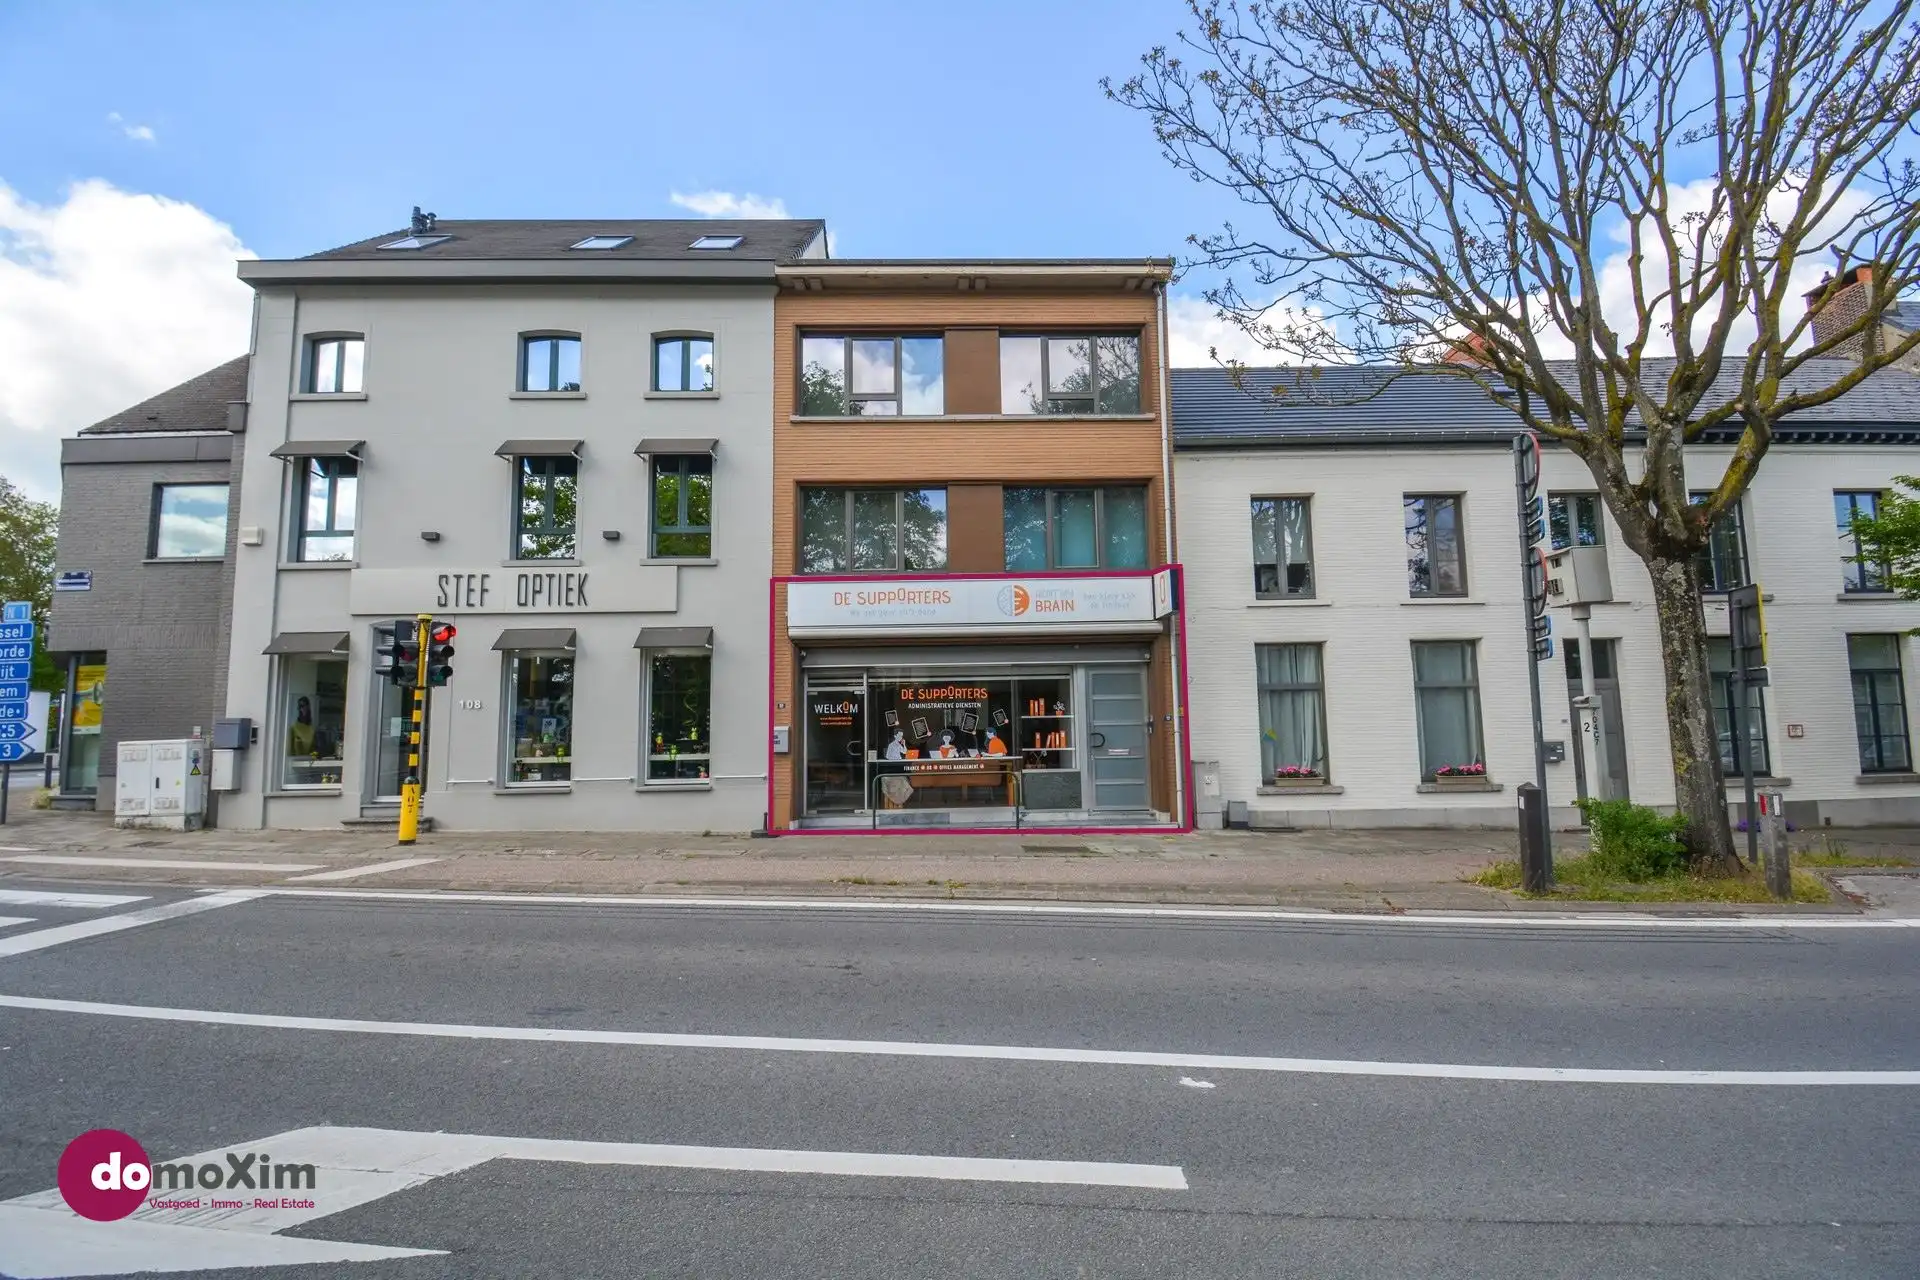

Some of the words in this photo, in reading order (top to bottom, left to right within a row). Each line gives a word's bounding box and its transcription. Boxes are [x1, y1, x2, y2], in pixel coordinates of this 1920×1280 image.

[437, 573, 491, 607] STEF
[517, 573, 589, 607] OPTIEK
[834, 591, 852, 606] DE
[856, 587, 952, 606] SUPPORTERS
[1035, 600, 1075, 613] BRAIN
[901, 689, 915, 700] DE
[918, 686, 988, 700] SUPPORTERS
[458, 699, 482, 710] 108
[814, 701, 859, 714] WELKOM
[7, 724, 16, 737] 5
[1583, 722, 1591, 733] 2
[2, 744, 12, 757] 3
